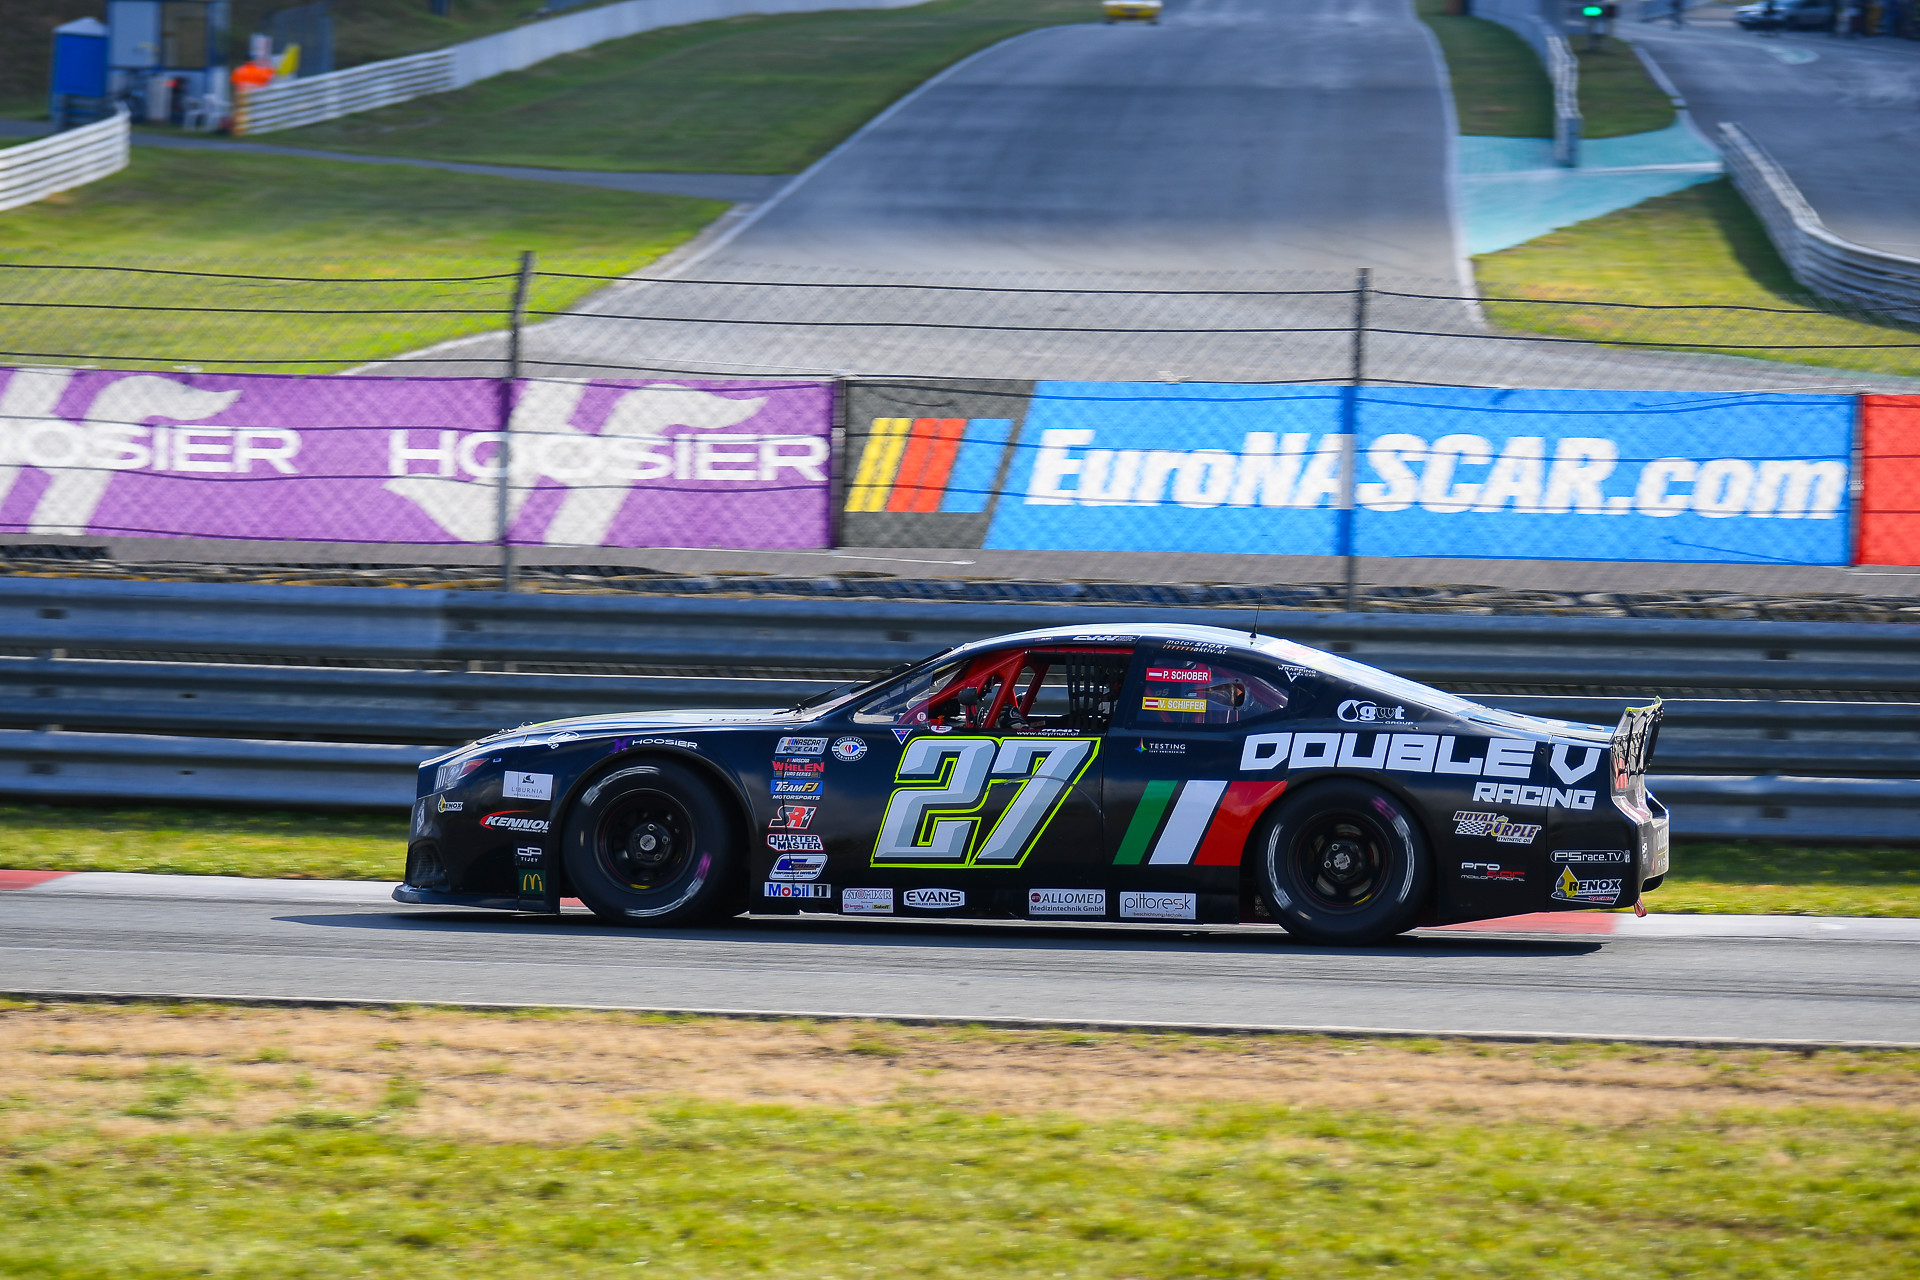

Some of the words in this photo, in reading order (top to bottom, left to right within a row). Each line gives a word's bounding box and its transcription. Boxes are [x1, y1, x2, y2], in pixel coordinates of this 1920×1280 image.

[0, 422, 301, 474] OSIER
[388, 429, 831, 482] HOOSIER
[1023, 428, 1849, 519] EuroNASCAR.com
[1162, 670, 1170, 680] P.
[1171, 670, 1209, 681] SCHOBER
[1159, 699, 1166, 709] V.
[1167, 700, 1205, 710] SCHIFFER
[631, 738, 698, 749] HOOSIER
[793, 738, 822, 746] NASCAR
[1239, 731, 1537, 779] DOUBLE
[1549, 743, 1602, 785] V
[772, 761, 825, 773] WHELEN
[511, 786, 543, 795] LIBURNIA
[1472, 781, 1597, 811] RACING
[870, 735, 1101, 868] 27
[484, 815, 549, 830] KENNOL
[1454, 811, 1497, 822] ROYAL
[1481, 821, 1539, 838] PURPLE
[768, 834, 819, 845] QUARTER
[777, 842, 822, 850] MASTER
[768, 883, 810, 897] Mobil
[1568, 879, 1621, 892] RENOX
[906, 891, 961, 902] EVANS
[1041, 892, 1104, 904] ALLOMED
[1124, 893, 1191, 912] pittoresk
